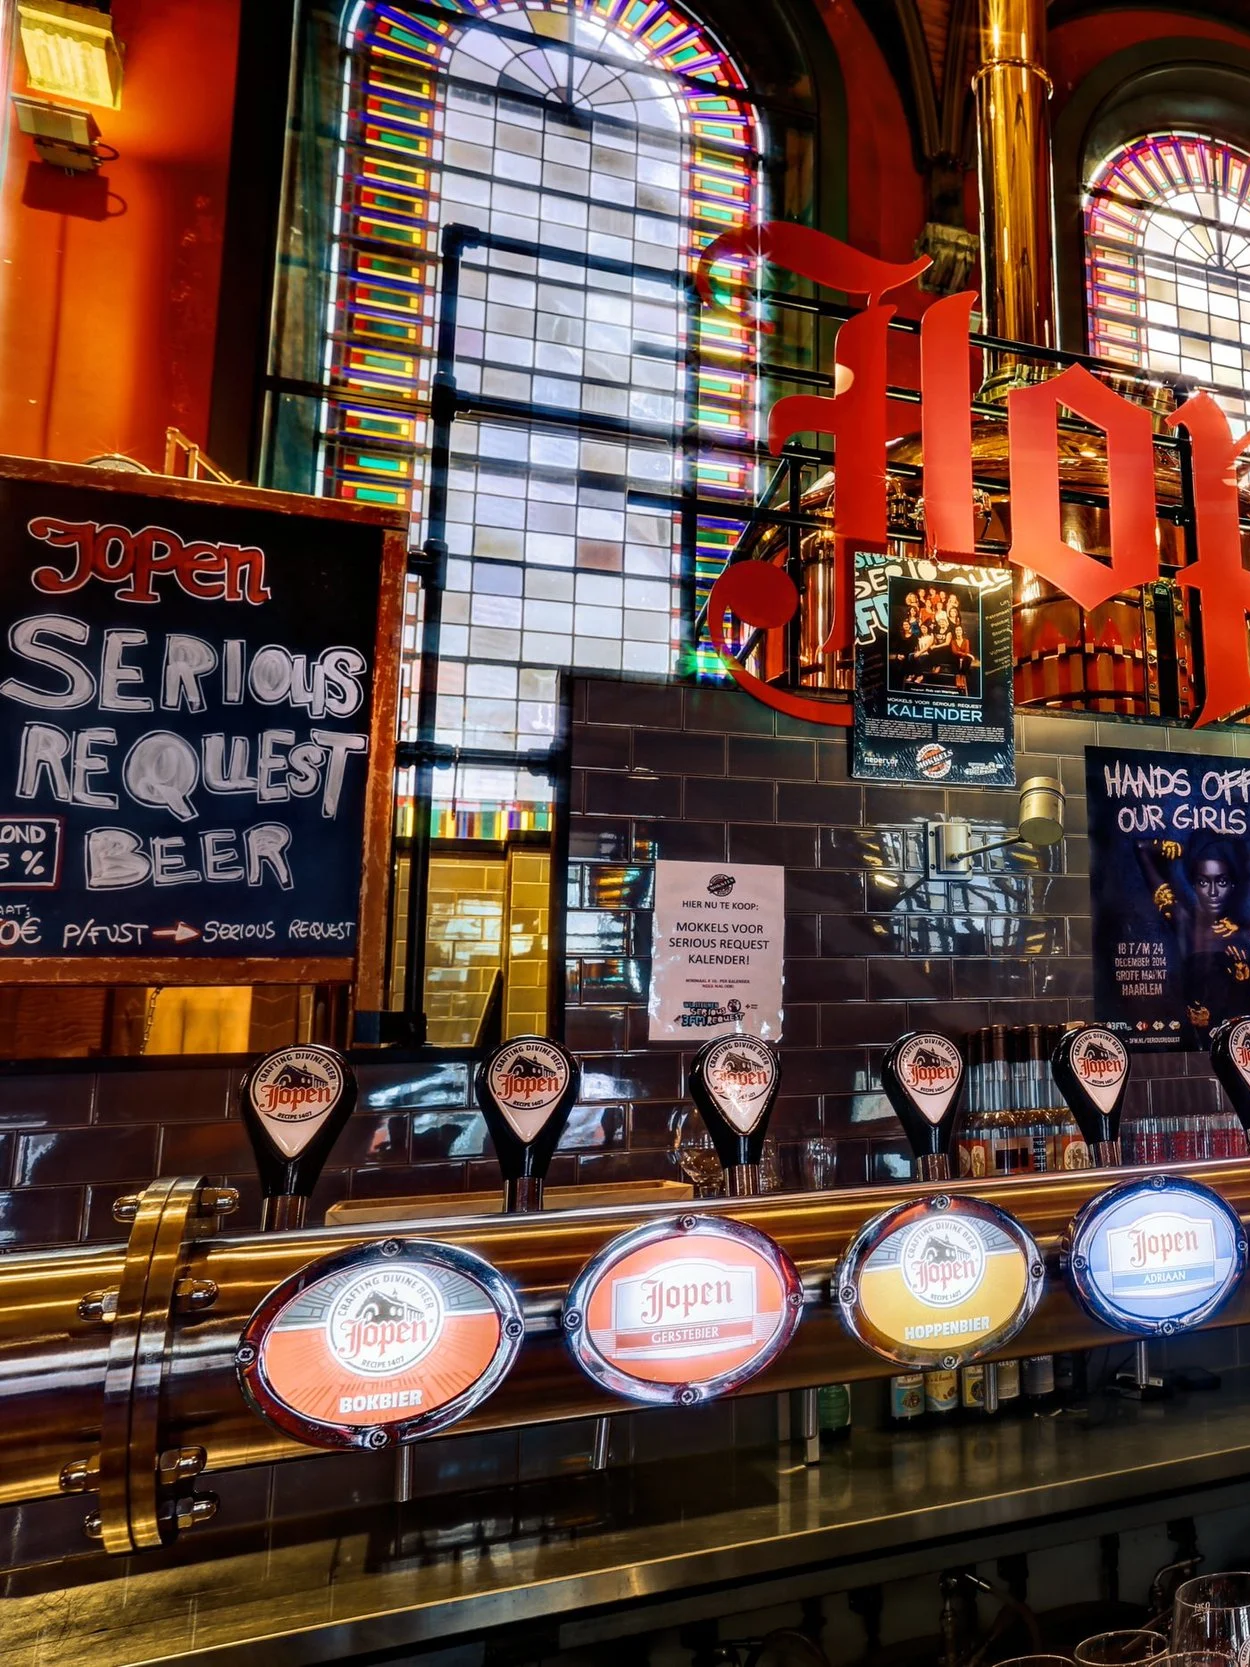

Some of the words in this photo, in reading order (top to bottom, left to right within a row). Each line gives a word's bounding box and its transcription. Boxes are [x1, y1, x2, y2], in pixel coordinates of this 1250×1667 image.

[0, 615, 366, 719] SERIOUS
[887, 704, 982, 722] KALENDER
[916, 750, 954, 768] MOKKELS
[16, 722, 368, 820] REQUEST
[1104, 759, 1191, 798] HANDS
[1118, 805, 1166, 832] OUR
[1172, 803, 1247, 835] GIRLS
[0, 825, 46, 844] OND
[86, 823, 293, 890] BEER
[682, 900, 702, 909] HIER
[704, 901, 717, 909] NU
[720, 902, 730, 910] TE
[732, 902, 759, 911] KOOP:
[203, 921, 275, 942] SERIOUS
[289, 920, 355, 940] REQUEST
[676, 922, 729, 933] MOKKELS
[732, 924, 763, 934] VOOR
[669, 938, 716, 948] SERIOUS
[720, 940, 769, 949] REQUEST
[1129, 943, 1150, 955] T/M
[1153, 943, 1163, 954] 24
[689, 955, 749, 965] KALENDER!
[1115, 957, 1149, 967] DECEMBER
[1152, 957, 1167, 967] 2014
[1142, 970, 1167, 980] MARKT
[1122, 983, 1162, 996] HAARLEM
[707, 1012, 745, 1026] REQUEST
[495, 1046, 524, 1072] CRAFTING
[526, 1045, 550, 1056] DIVINE
[550, 1054, 563, 1071] BEER
[710, 1044, 733, 1068] CRAFTING
[734, 1042, 757, 1052] DIVINE
[757, 1049, 769, 1065] BEER
[925, 1039, 946, 1047] DIVINE
[945, 1046, 956, 1060] BEER
[259, 1054, 293, 1082] CRAFTING
[295, 1053, 324, 1065] DIVINE
[323, 1062, 336, 1080] BEER
[907, 1064, 955, 1087] Jopen
[1077, 1057, 1122, 1079] Jopen
[259, 1084, 332, 1112] Jopen
[496, 1074, 559, 1100] Jopen
[908, 1225, 935, 1258] CRAFTING
[935, 1222, 962, 1234] DIVINE
[962, 1229, 977, 1251] BEER
[1128, 1228, 1199, 1267] Jopen
[911, 1259, 976, 1295] Jopen
[1144, 1270, 1186, 1284] ADRIAAN
[338, 1277, 380, 1316] CRAFTING
[383, 1275, 417, 1288] DIVINE
[417, 1287, 434, 1309] BEER
[640, 1279, 734, 1324] Jopen
[338, 1319, 427, 1359] Jopen
[651, 1327, 719, 1344] GERSTEBIER
[904, 1316, 992, 1340] HOPPENBIER
[339, 1389, 423, 1414] BOKBIER
